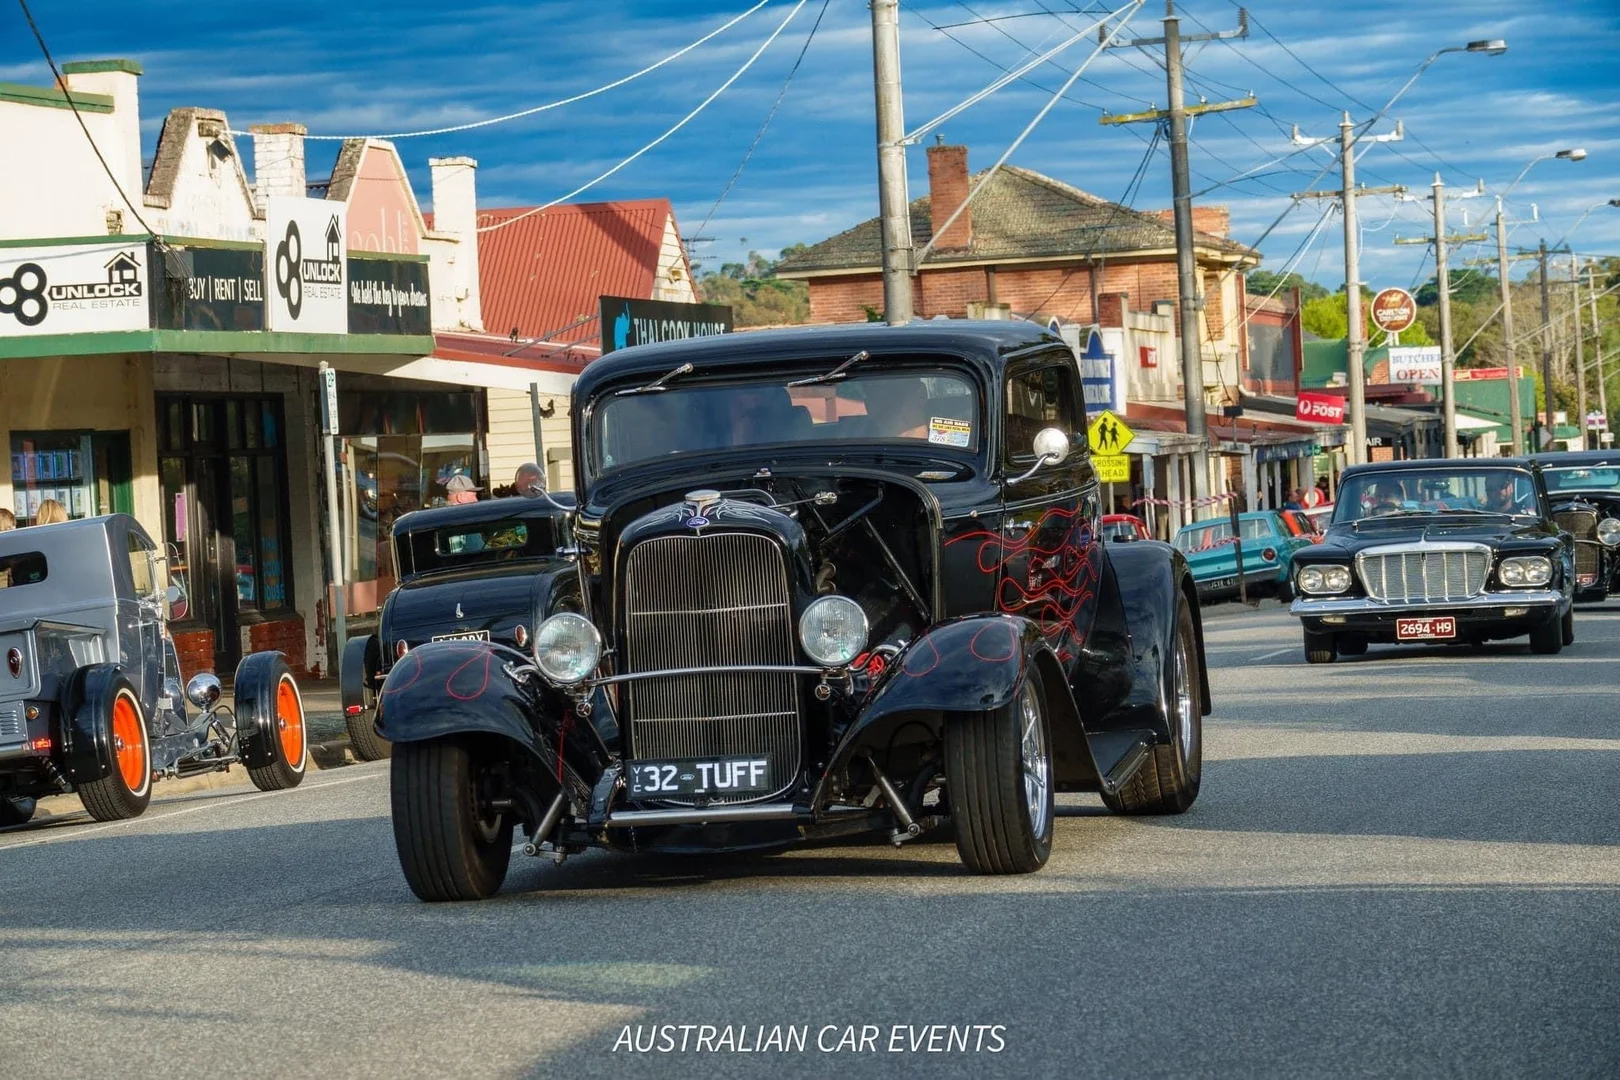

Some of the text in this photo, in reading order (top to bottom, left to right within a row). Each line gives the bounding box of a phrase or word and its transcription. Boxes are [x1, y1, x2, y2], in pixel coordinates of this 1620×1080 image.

[303, 261, 341, 282] UNLOCK
[52, 283, 140, 300] UNLOCK
[214, 278, 236, 300] RENT
[244, 279, 263, 302] SELL
[303, 285, 342, 299] REAL ESTATE
[52, 298, 140, 311] REAL ESTATE
[633, 317, 659, 346] THAI
[661, 319, 690, 342] COOK
[1396, 367, 1440, 381] OPEN
[1312, 405, 1343, 418] POST
[1098, 469, 1124, 477] HEAD
[643, 760, 767, 792] 32 TUFF
